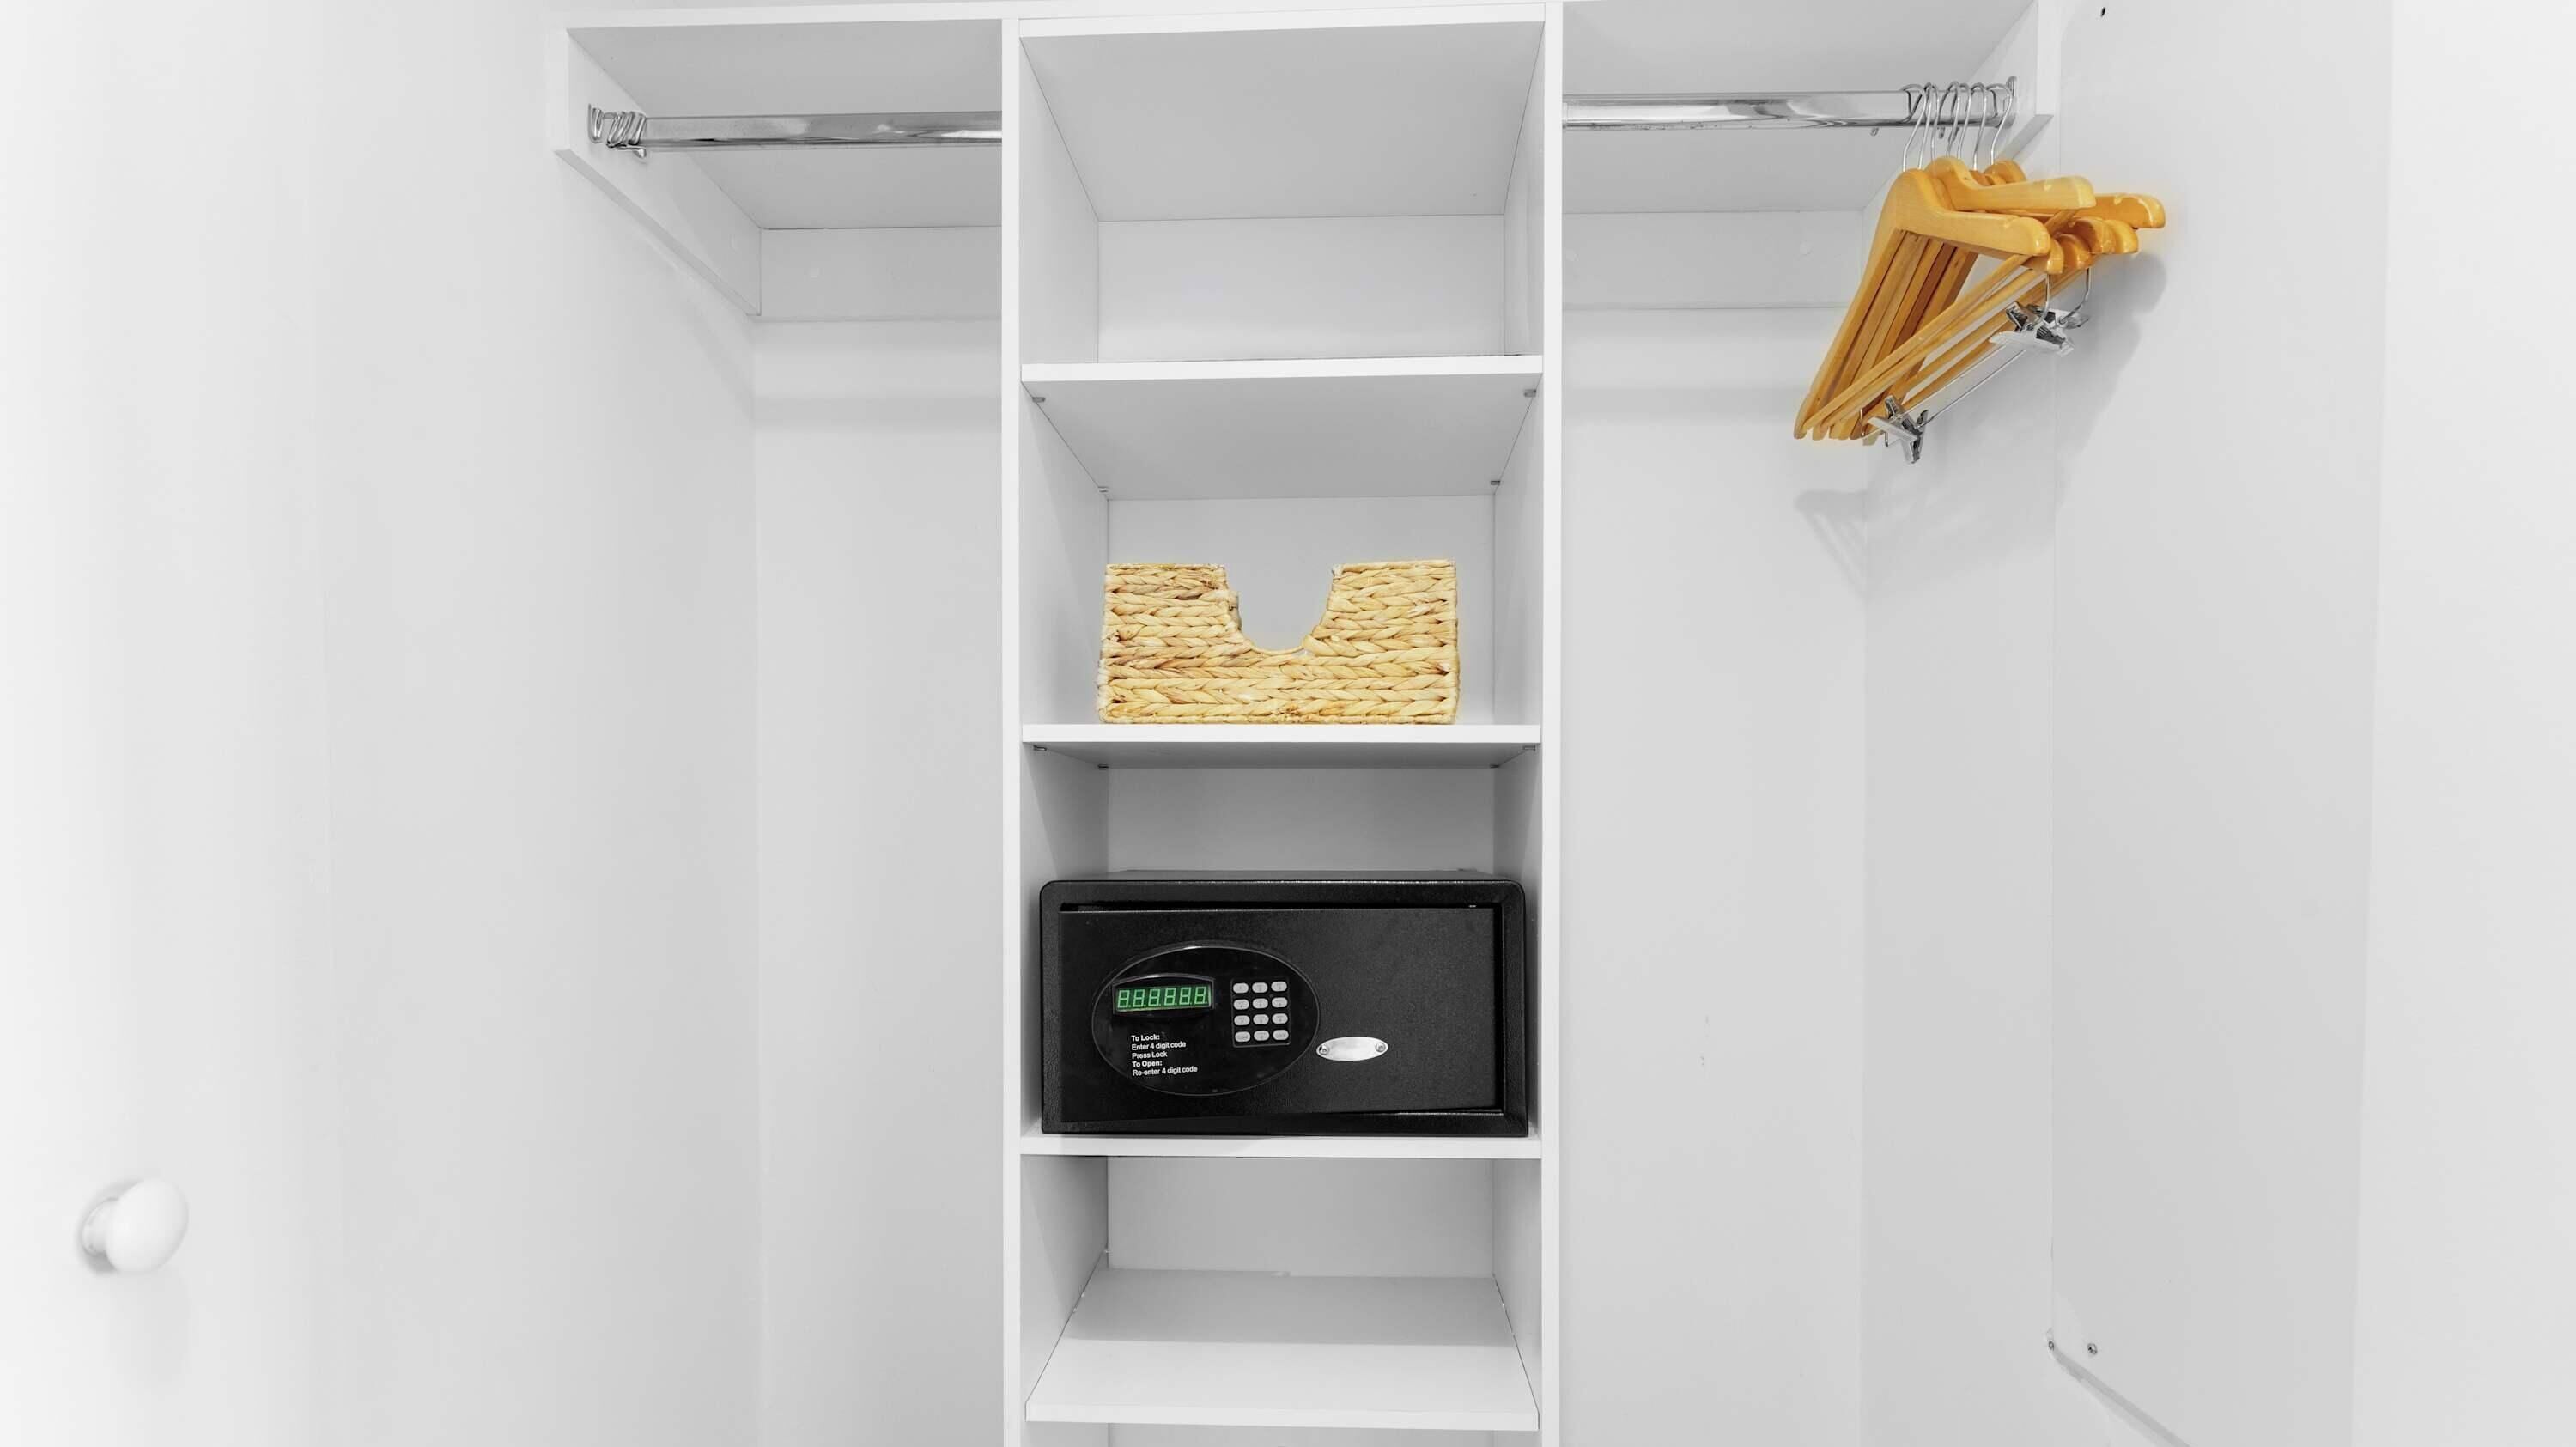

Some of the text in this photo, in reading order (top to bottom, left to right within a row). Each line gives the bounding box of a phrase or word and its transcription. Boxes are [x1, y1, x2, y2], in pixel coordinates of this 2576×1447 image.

[1155, 1042, 1170, 1050] digit
[1141, 1060, 1163, 1068] Open:
[1167, 1067, 1182, 1075] digit
